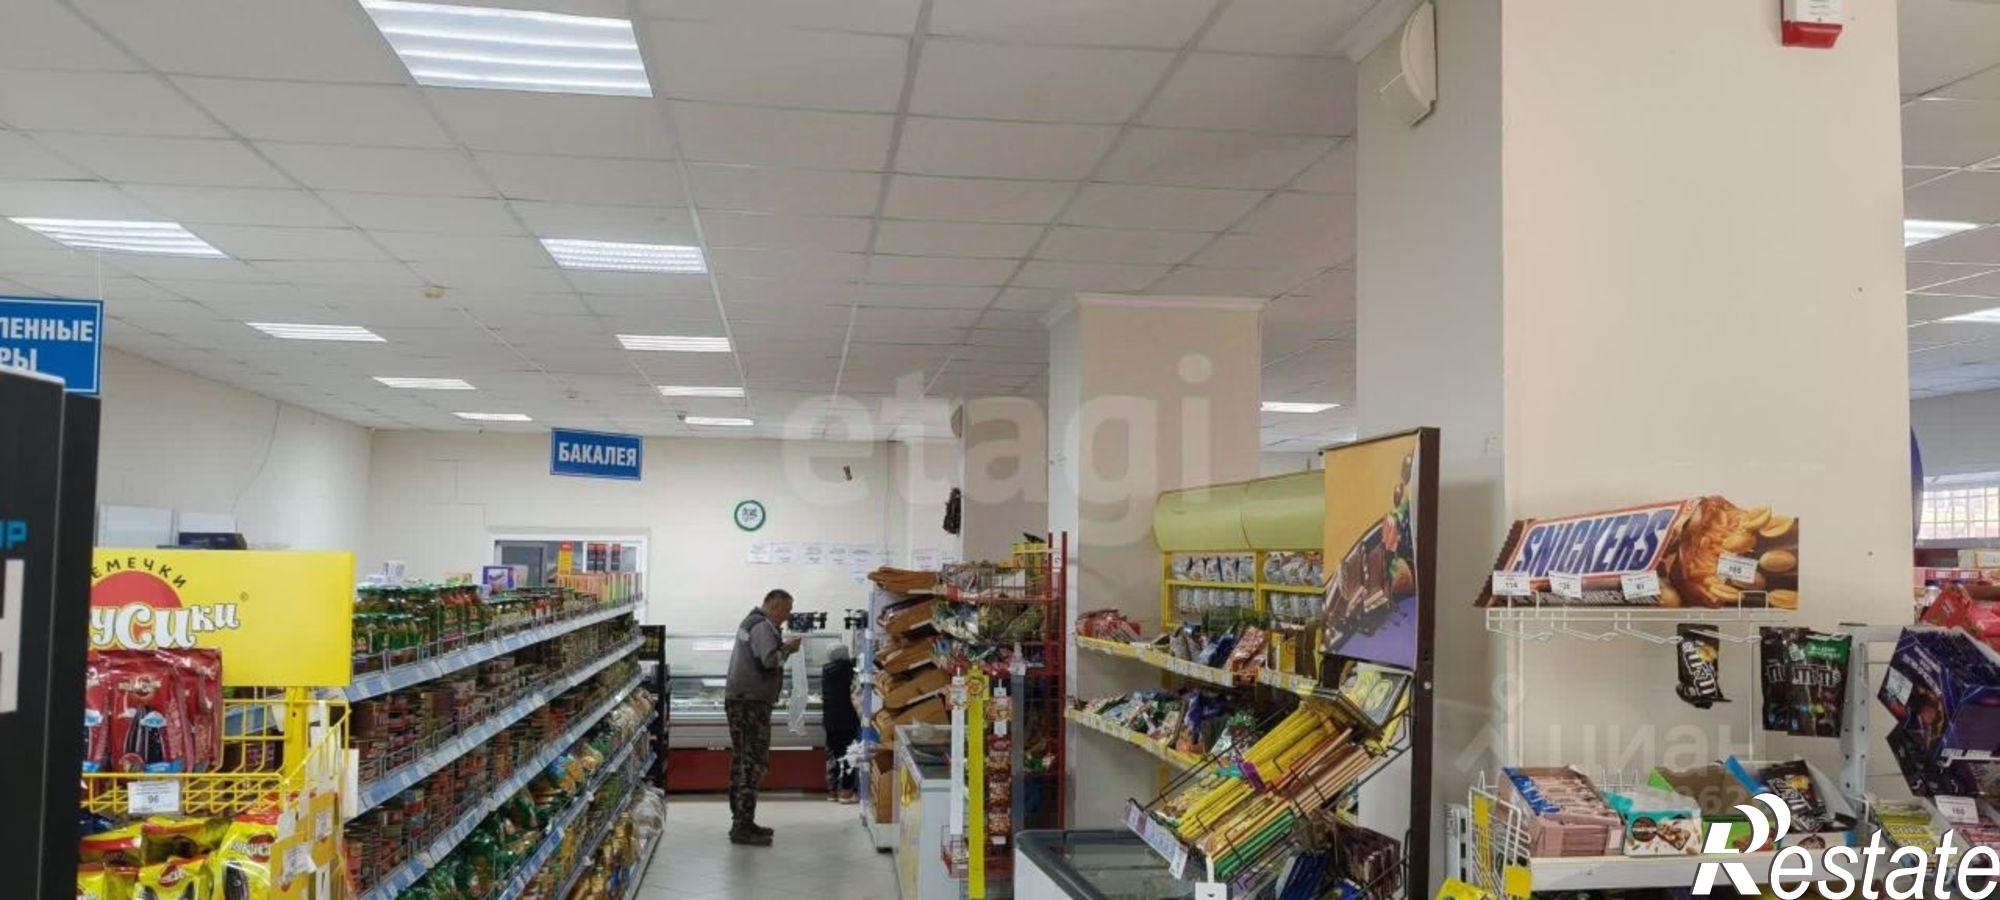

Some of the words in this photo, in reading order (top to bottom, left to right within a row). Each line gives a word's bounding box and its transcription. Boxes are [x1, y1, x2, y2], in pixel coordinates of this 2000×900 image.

[558, 441, 637, 467] БАКАЛЕЯ
[1513, 508, 1677, 578] SNICKERS
[91, 556, 187, 588] ЕМЕЧКИ
